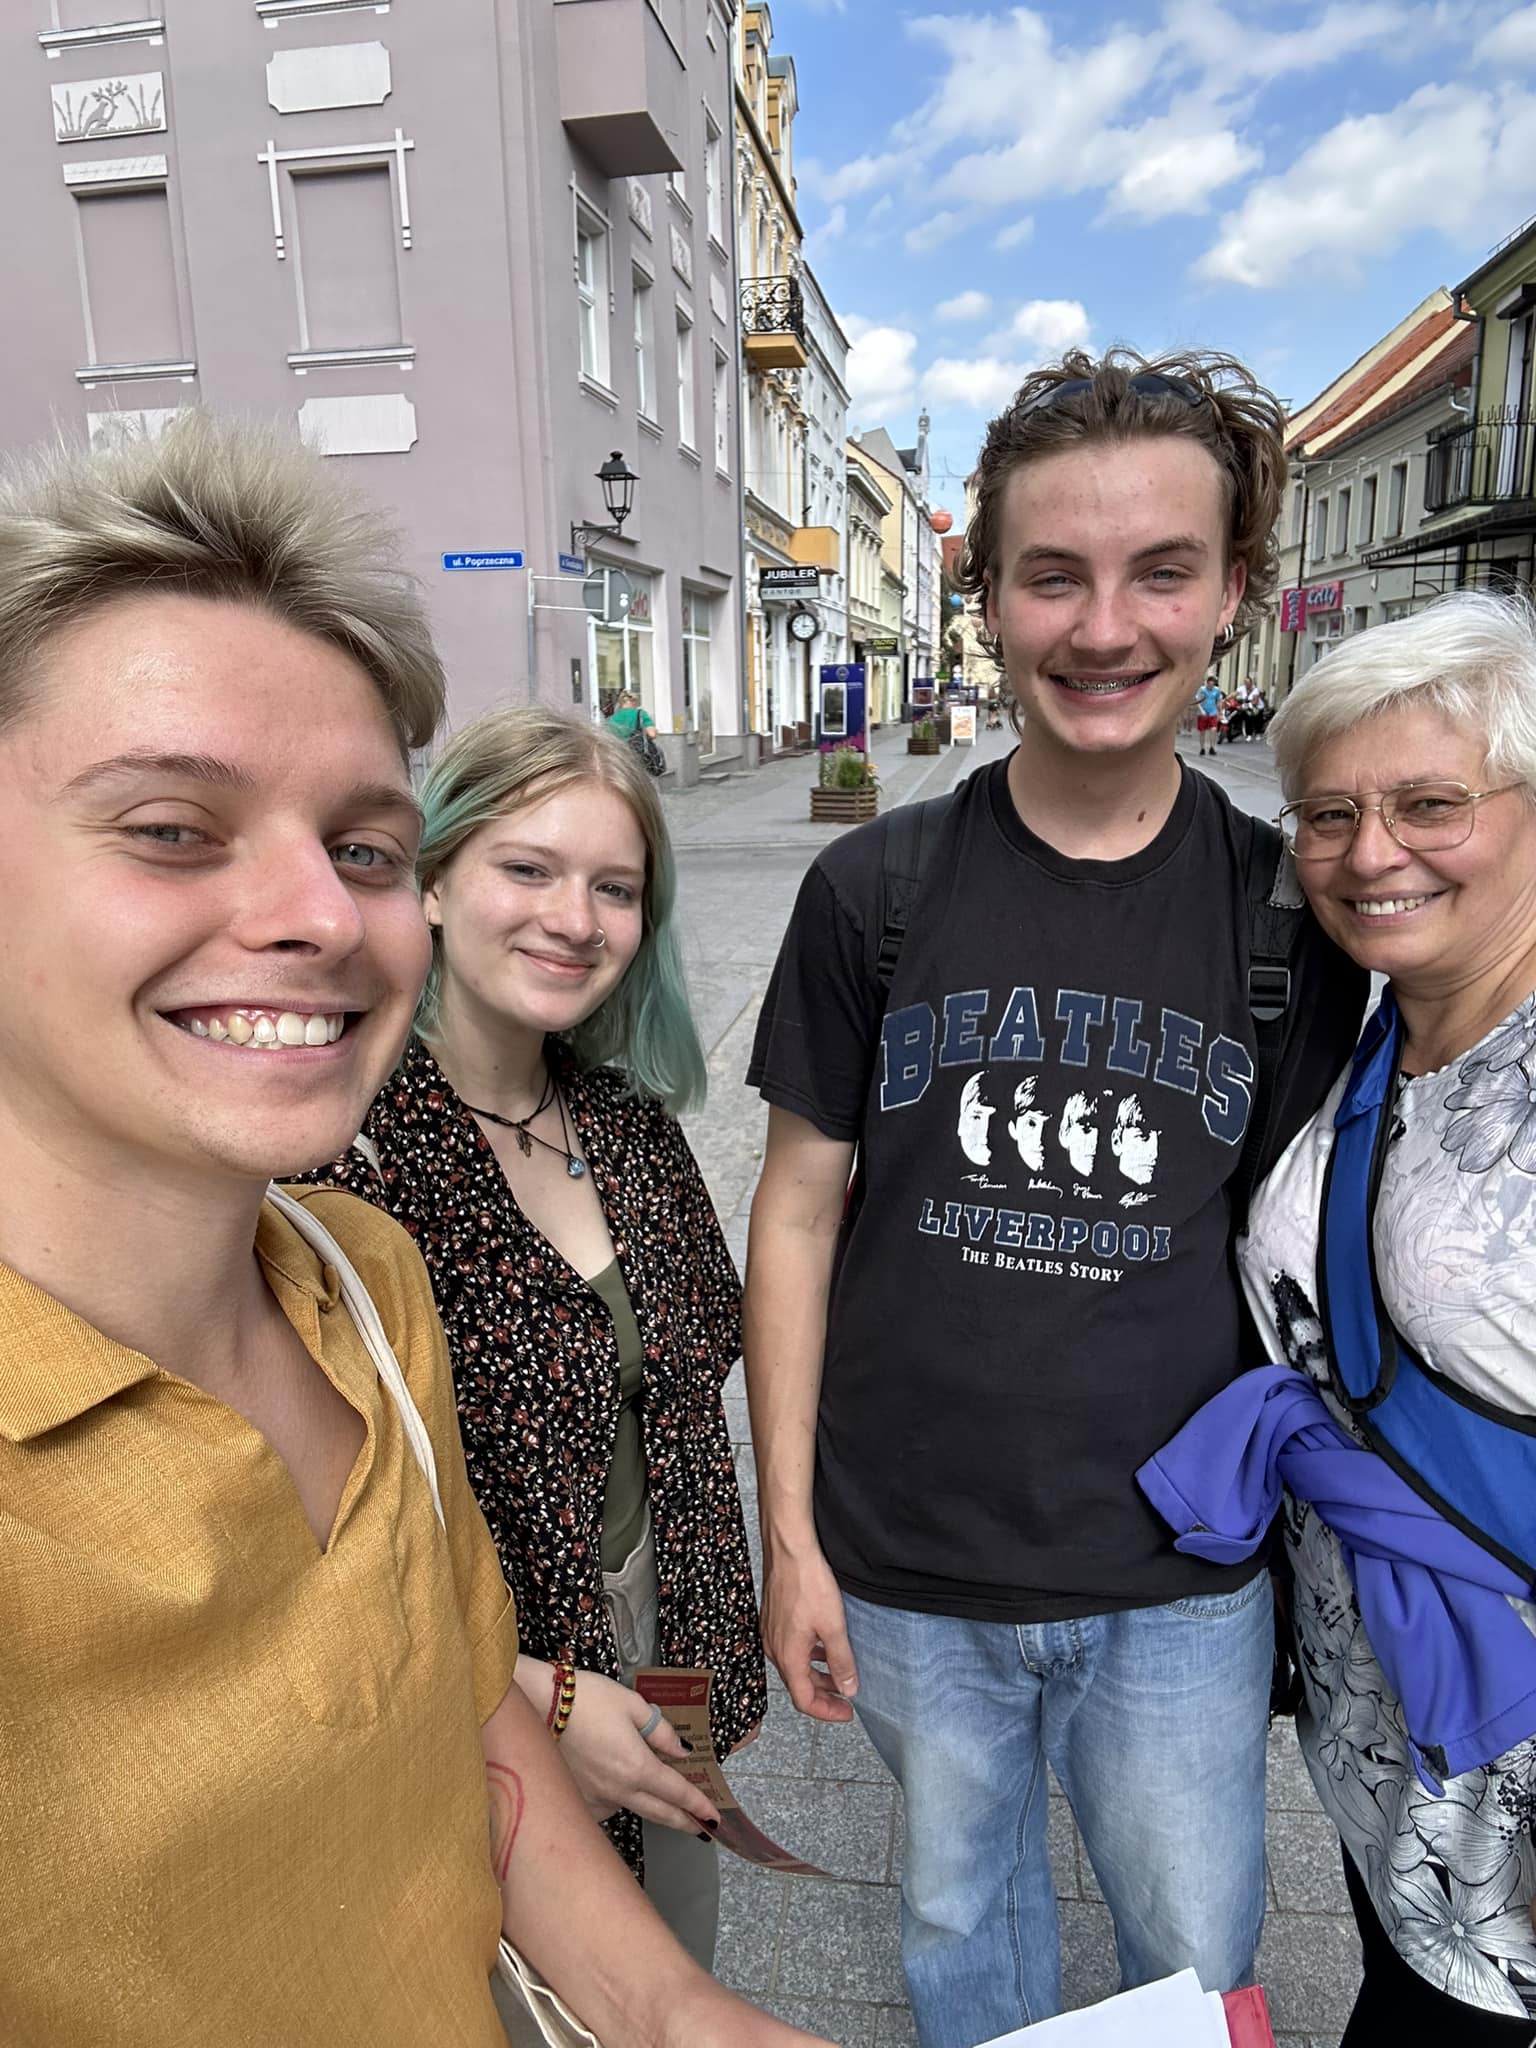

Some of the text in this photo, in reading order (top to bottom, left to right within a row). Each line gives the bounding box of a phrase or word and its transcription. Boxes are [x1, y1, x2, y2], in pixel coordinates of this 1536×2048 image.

[452, 556, 515, 567] ul. Poprzeczna
[764, 569, 817, 579] JUBILER
[880, 986, 1254, 1146] BEATLES
